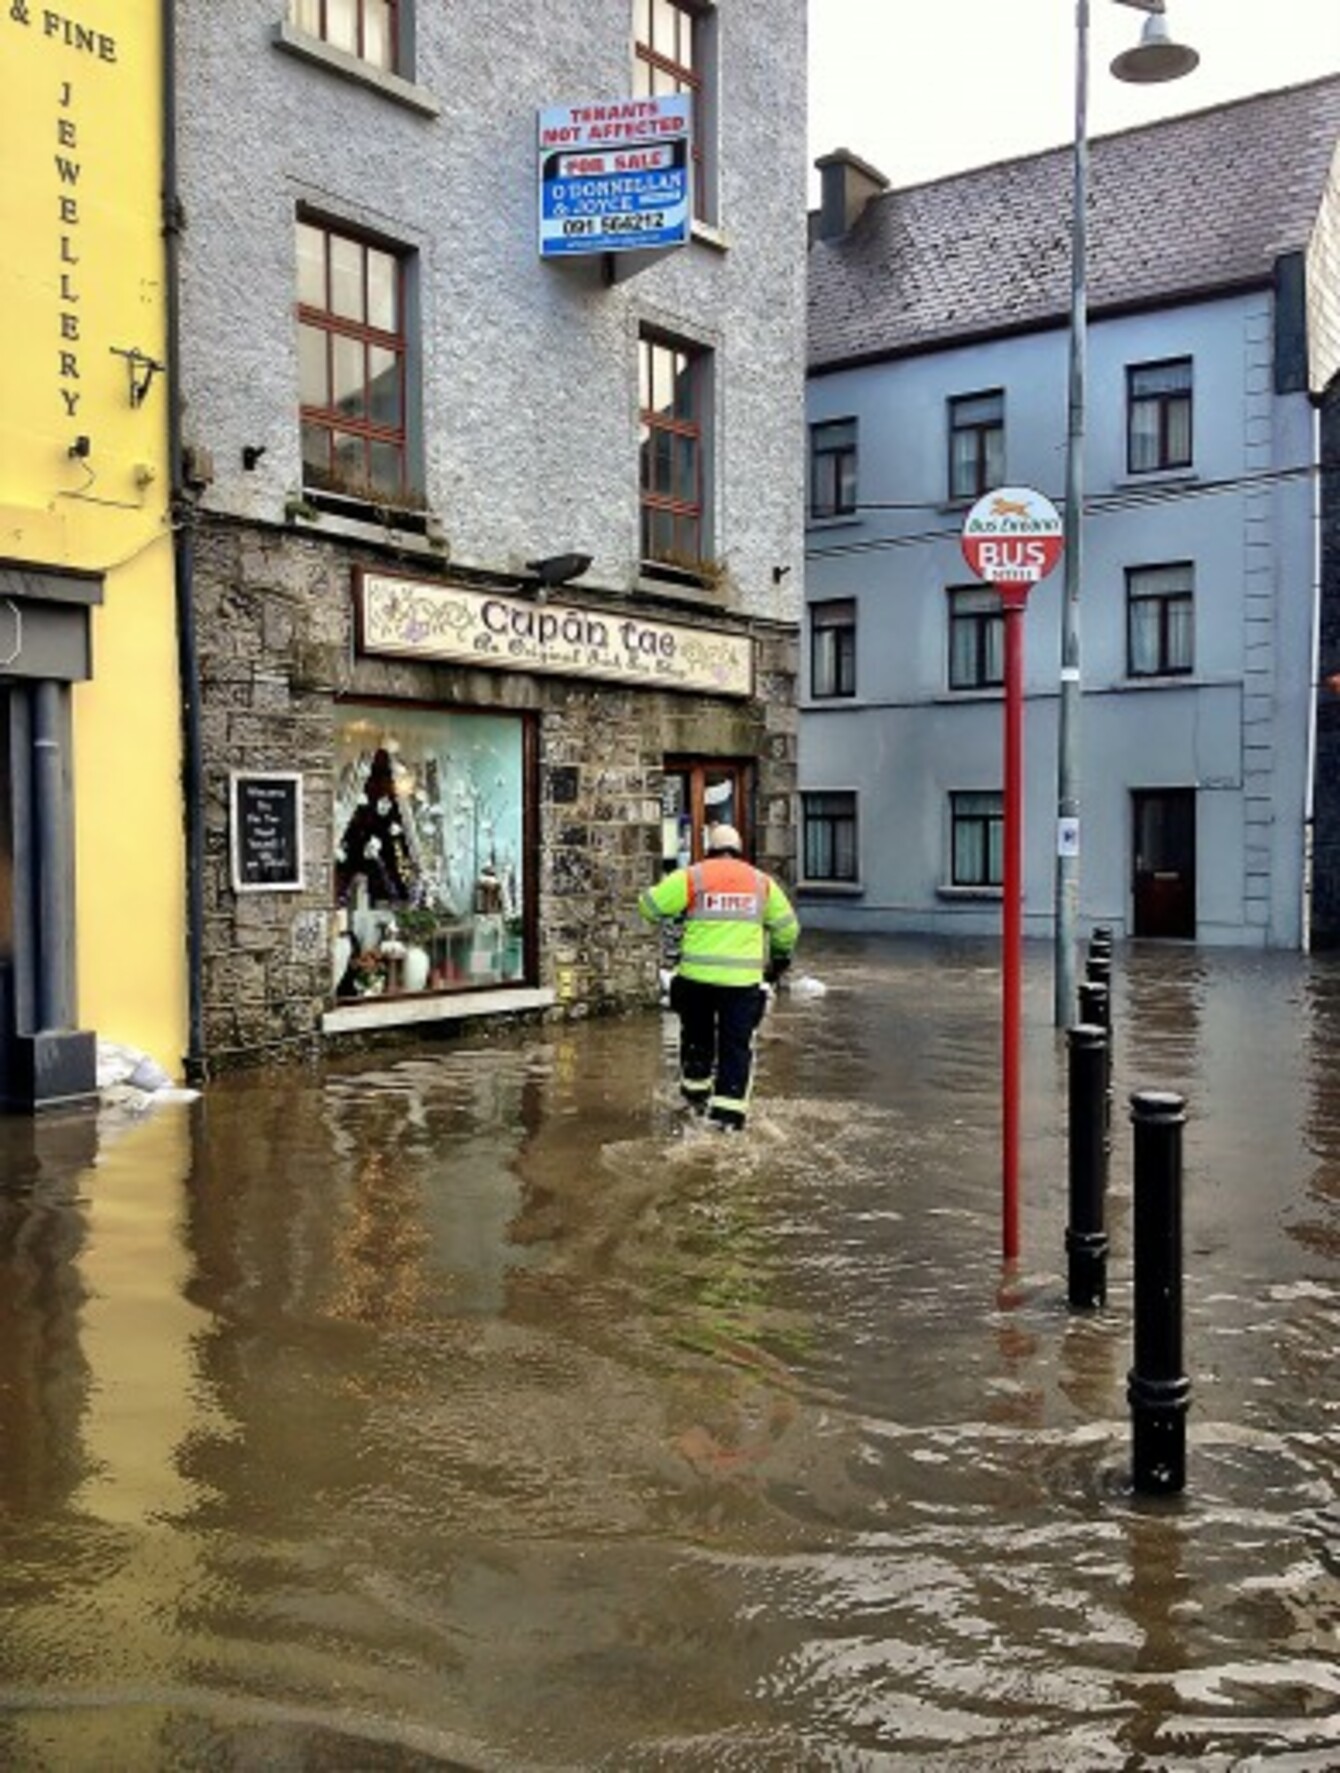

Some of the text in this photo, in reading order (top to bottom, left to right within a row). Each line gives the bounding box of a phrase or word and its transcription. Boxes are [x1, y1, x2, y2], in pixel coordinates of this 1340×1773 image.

[43, 10, 118, 64] FINE
[570, 102, 659, 123] TENANTS
[543, 117, 684, 142] NOT AFFECTED
[565, 151, 662, 173] FOR SALE
[563, 218, 592, 235] 091
[54, 82, 81, 418] JEWELLERY
[969, 518, 997, 533] Bus
[978, 542, 1046, 567] BUS
